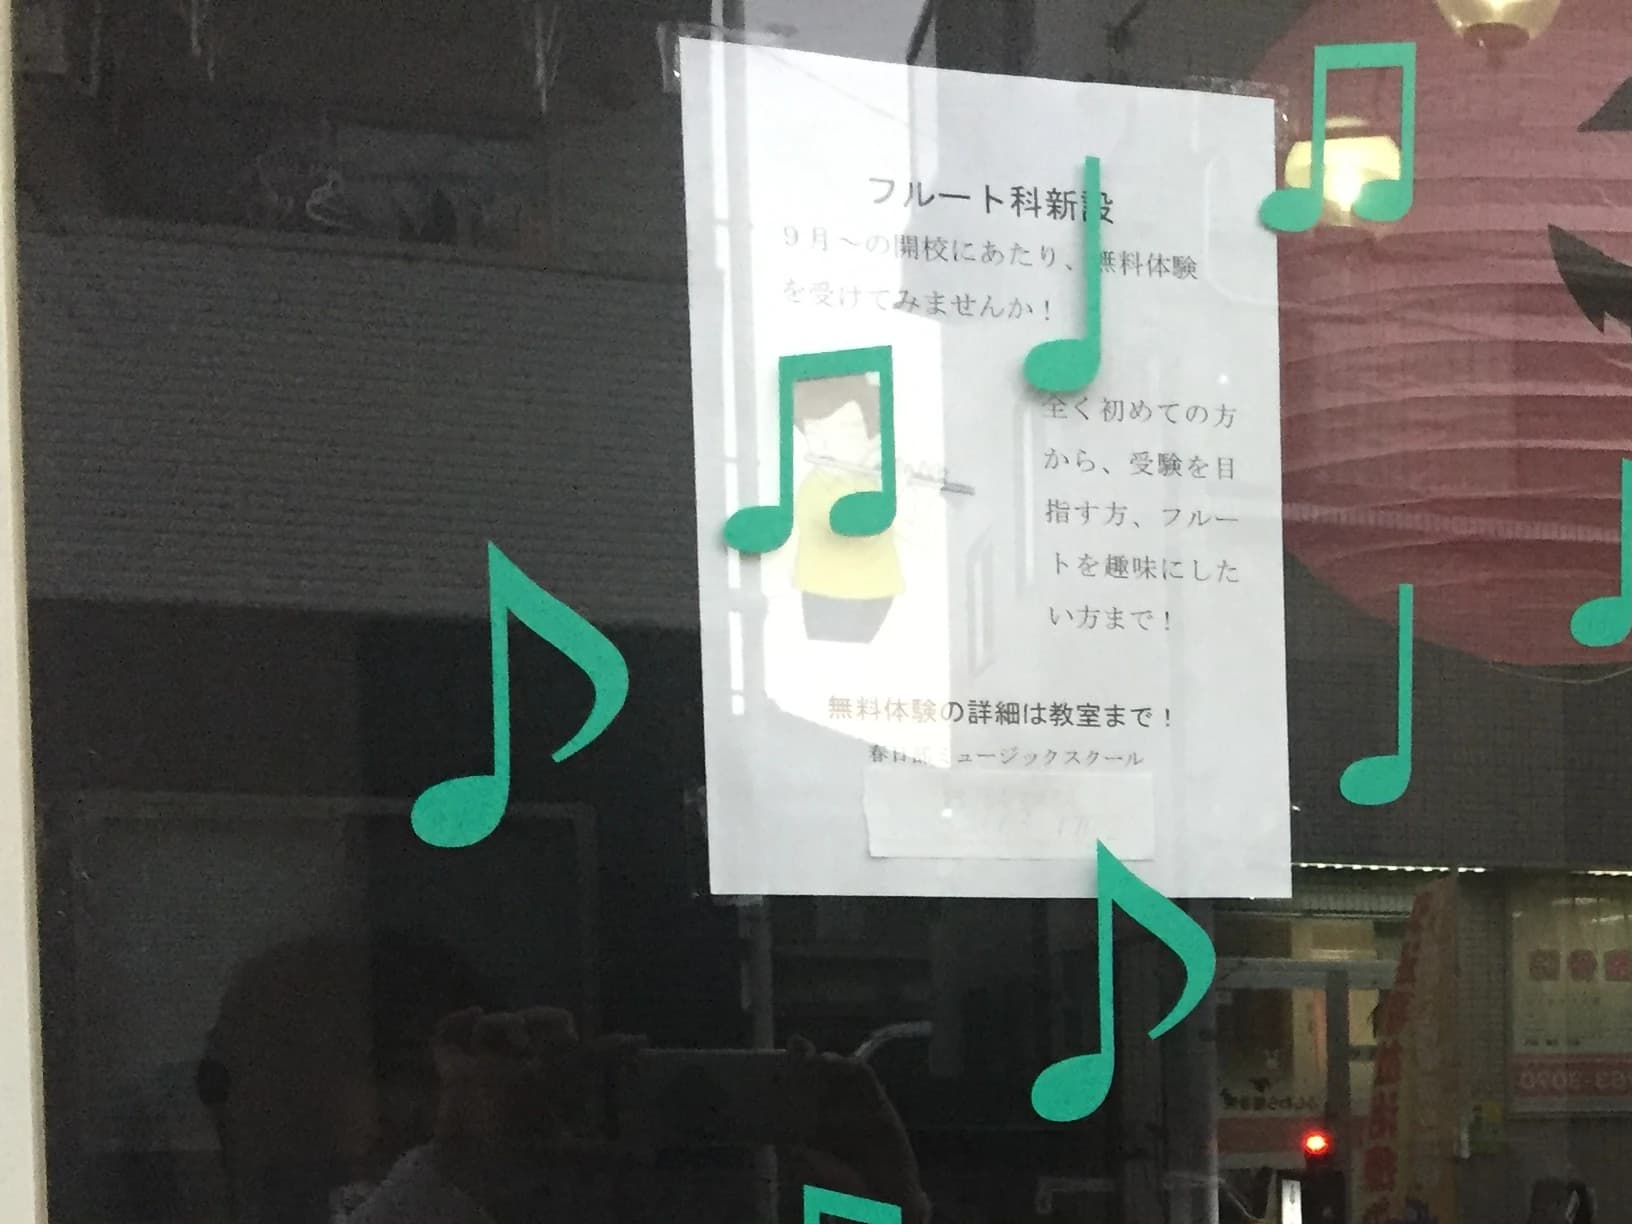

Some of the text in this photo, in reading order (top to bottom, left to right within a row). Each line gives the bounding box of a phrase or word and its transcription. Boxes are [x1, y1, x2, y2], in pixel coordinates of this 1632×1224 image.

[1041, 396, 1237, 430] 全く初めての方
[1043, 447, 1235, 481] から、受験を目
[1044, 497, 1240, 529] 指す方、フルー
[1054, 551, 1240, 584] トを趣味にした
